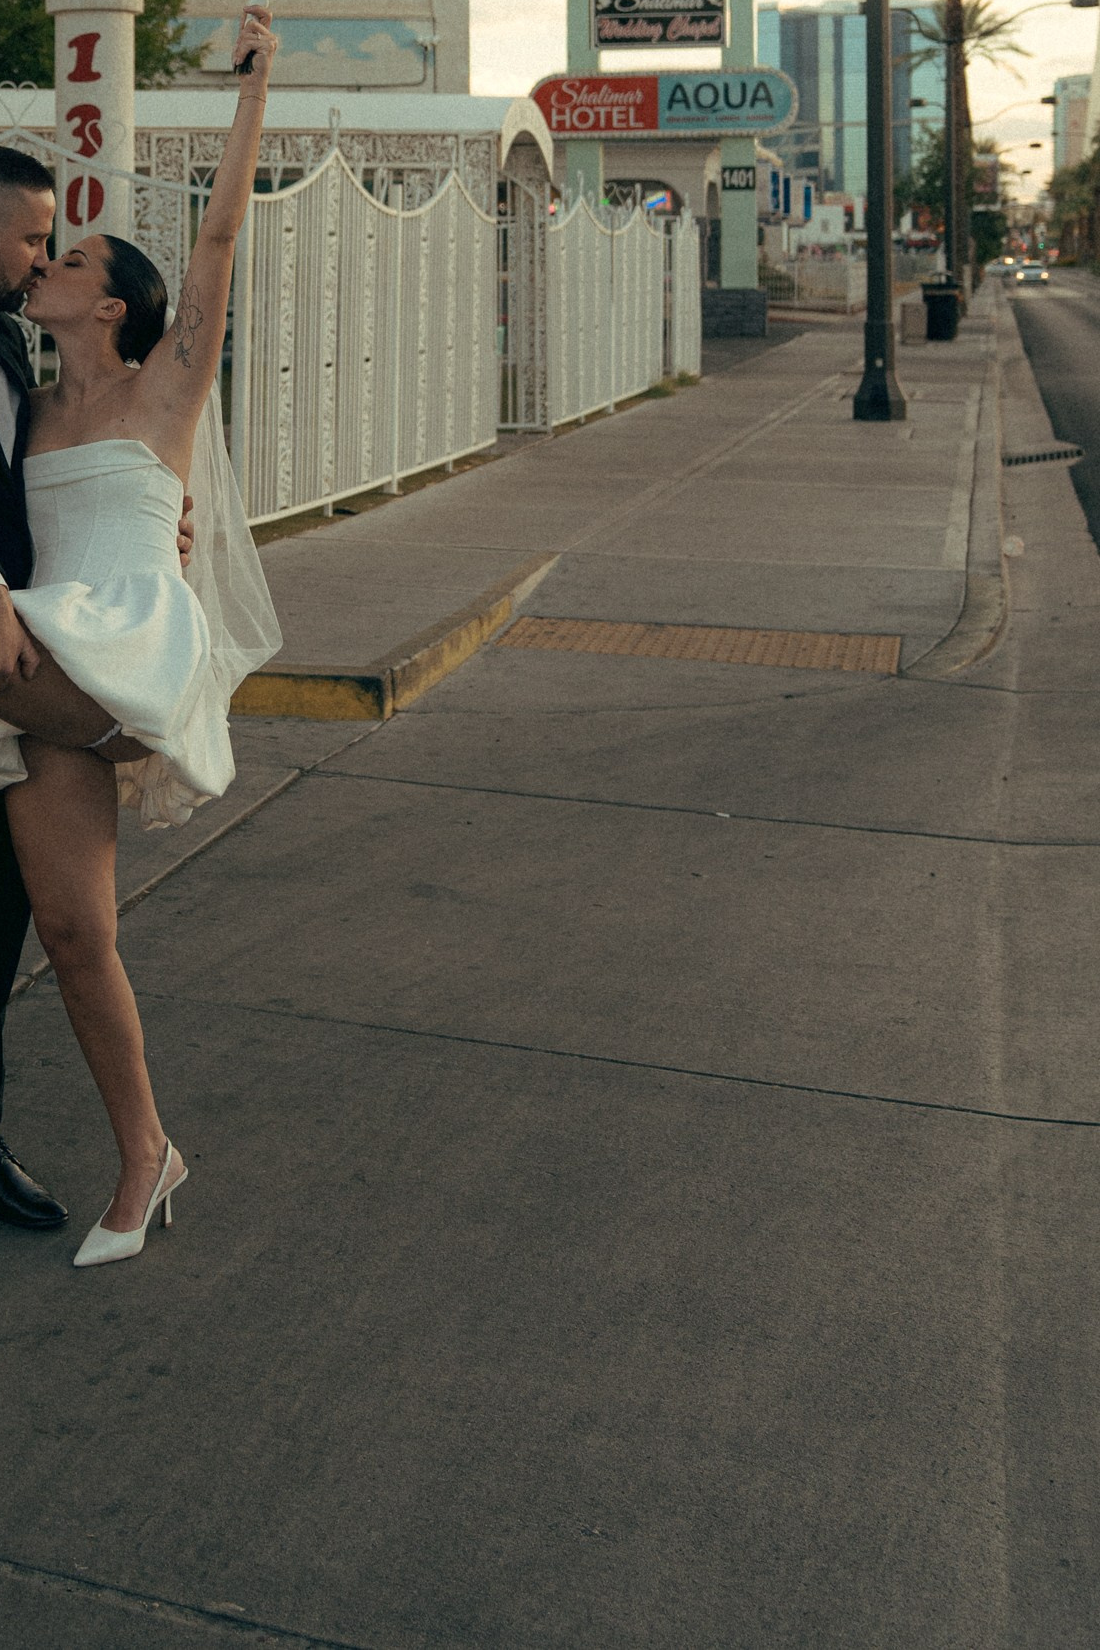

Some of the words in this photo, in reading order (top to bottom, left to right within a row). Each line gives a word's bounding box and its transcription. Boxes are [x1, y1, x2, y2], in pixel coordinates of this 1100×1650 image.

[551, 80, 644, 108] Shalimar
[667, 80, 774, 113] AQUA
[551, 106, 644, 129] HOTEL
[723, 170, 753, 188] 1401
